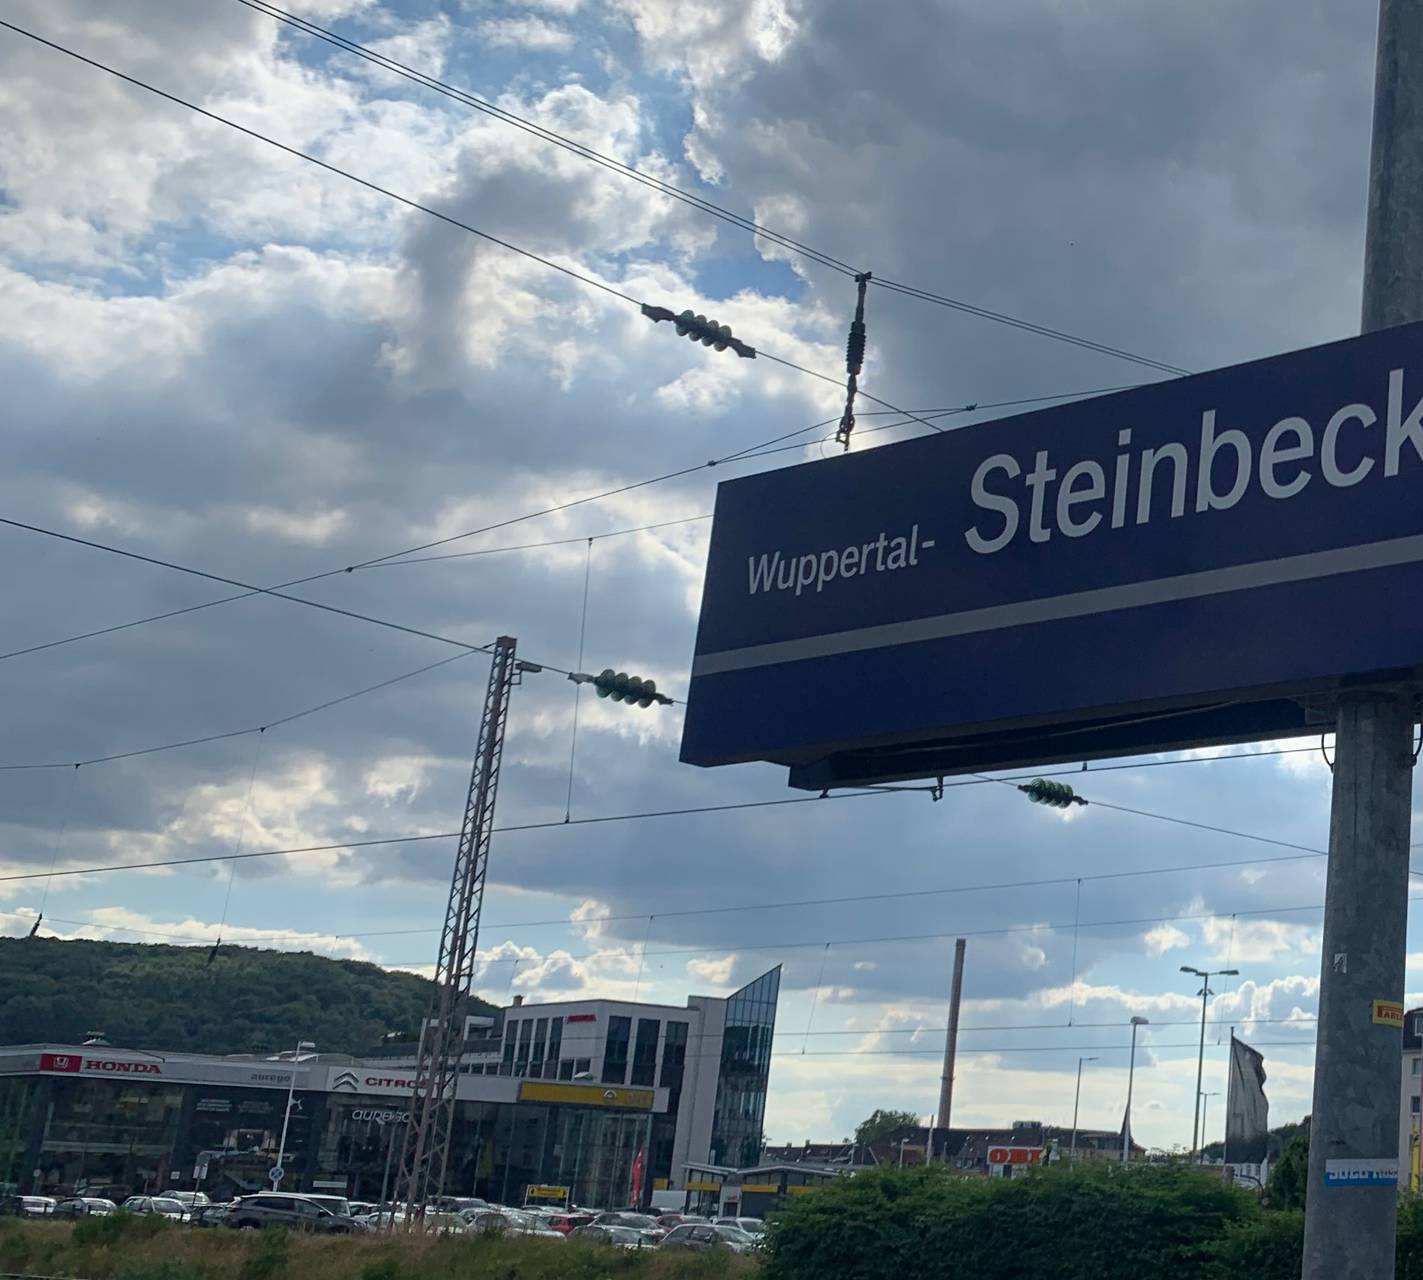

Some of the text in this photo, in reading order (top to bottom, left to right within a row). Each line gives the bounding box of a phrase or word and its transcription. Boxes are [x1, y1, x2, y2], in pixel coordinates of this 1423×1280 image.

[747, 524, 936, 597] Wuppertal-
[85, 1060, 162, 1074] HONDA
[365, 1077, 440, 1091] CITRO
